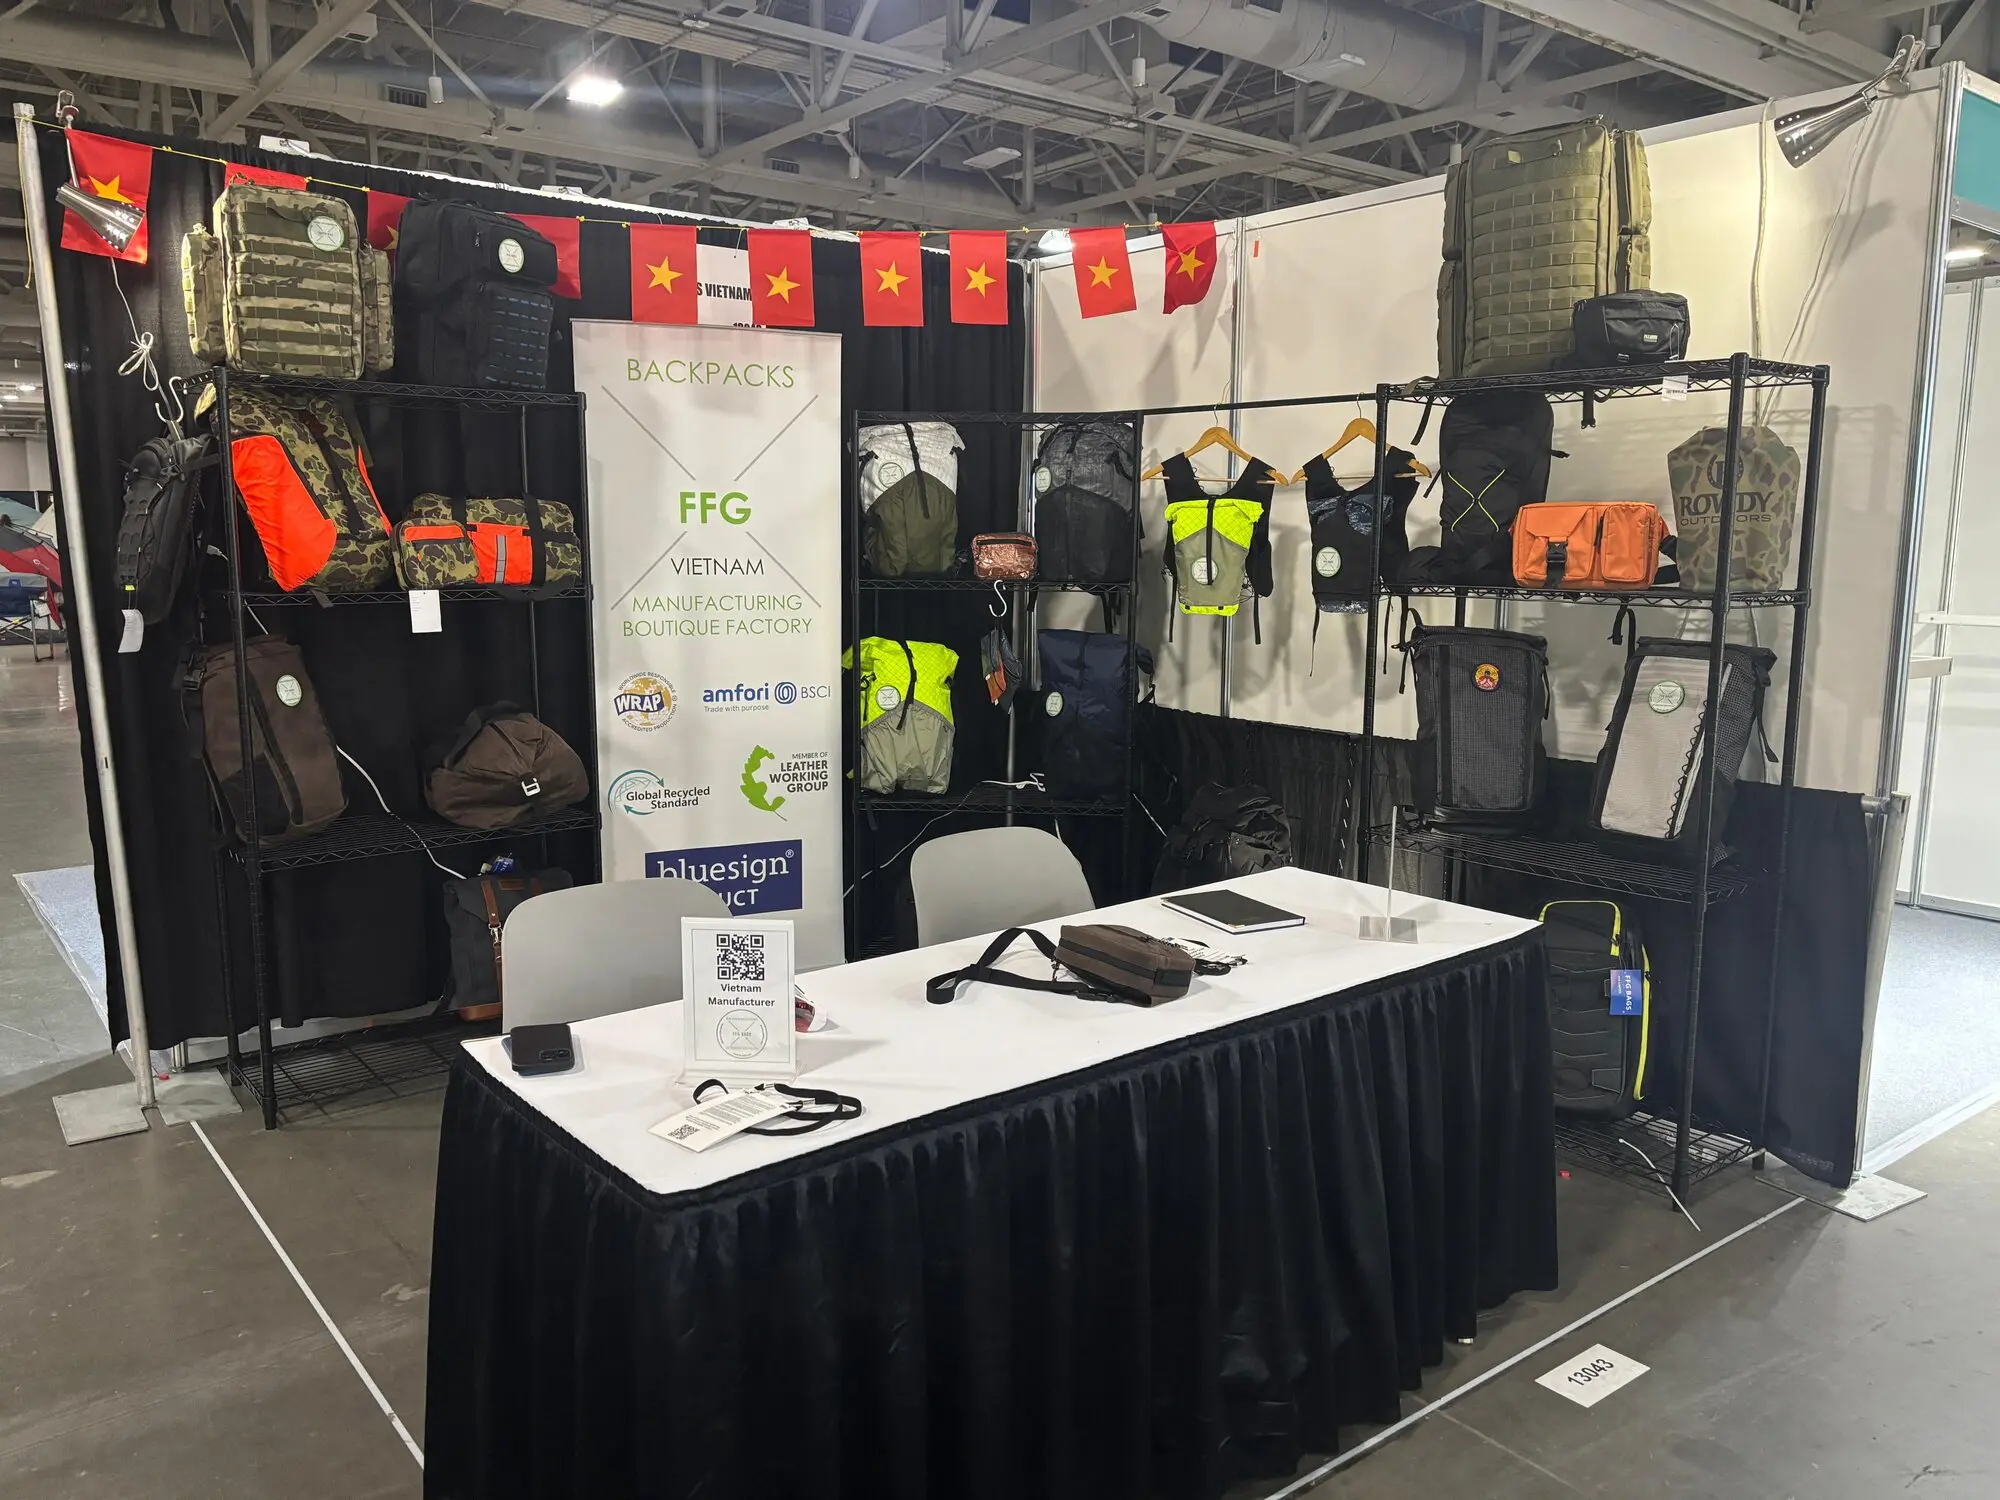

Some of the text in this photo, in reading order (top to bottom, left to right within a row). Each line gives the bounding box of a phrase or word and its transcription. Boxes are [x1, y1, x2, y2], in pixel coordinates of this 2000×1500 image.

[705, 283, 752, 301] VIETNAM
[627, 359, 794, 388] BACKPACKS
[680, 492, 752, 525] FFG
[670, 557, 765, 576] VIETNAM
[632, 595, 803, 613] MANUFACTURING
[622, 618, 813, 637] BOUTIQUE FACTORY
[702, 682, 831, 703] amfori BSCI
[616, 693, 662, 713] WRAP
[725, 704, 740, 712] with
[741, 703, 769, 712] purpose
[780, 760, 828, 772] LEATHER
[769, 771, 829, 784] WORKING
[626, 785, 710, 802] Global Recycled
[786, 781, 829, 793] GROUP
[650, 796, 699, 810] Standard
[720, 983, 762, 993] Vietnam
[708, 997, 776, 1007] Manufacturer
[1625, 990, 1633, 1011] BAGS
[1567, 1358, 1614, 1386] 13043
